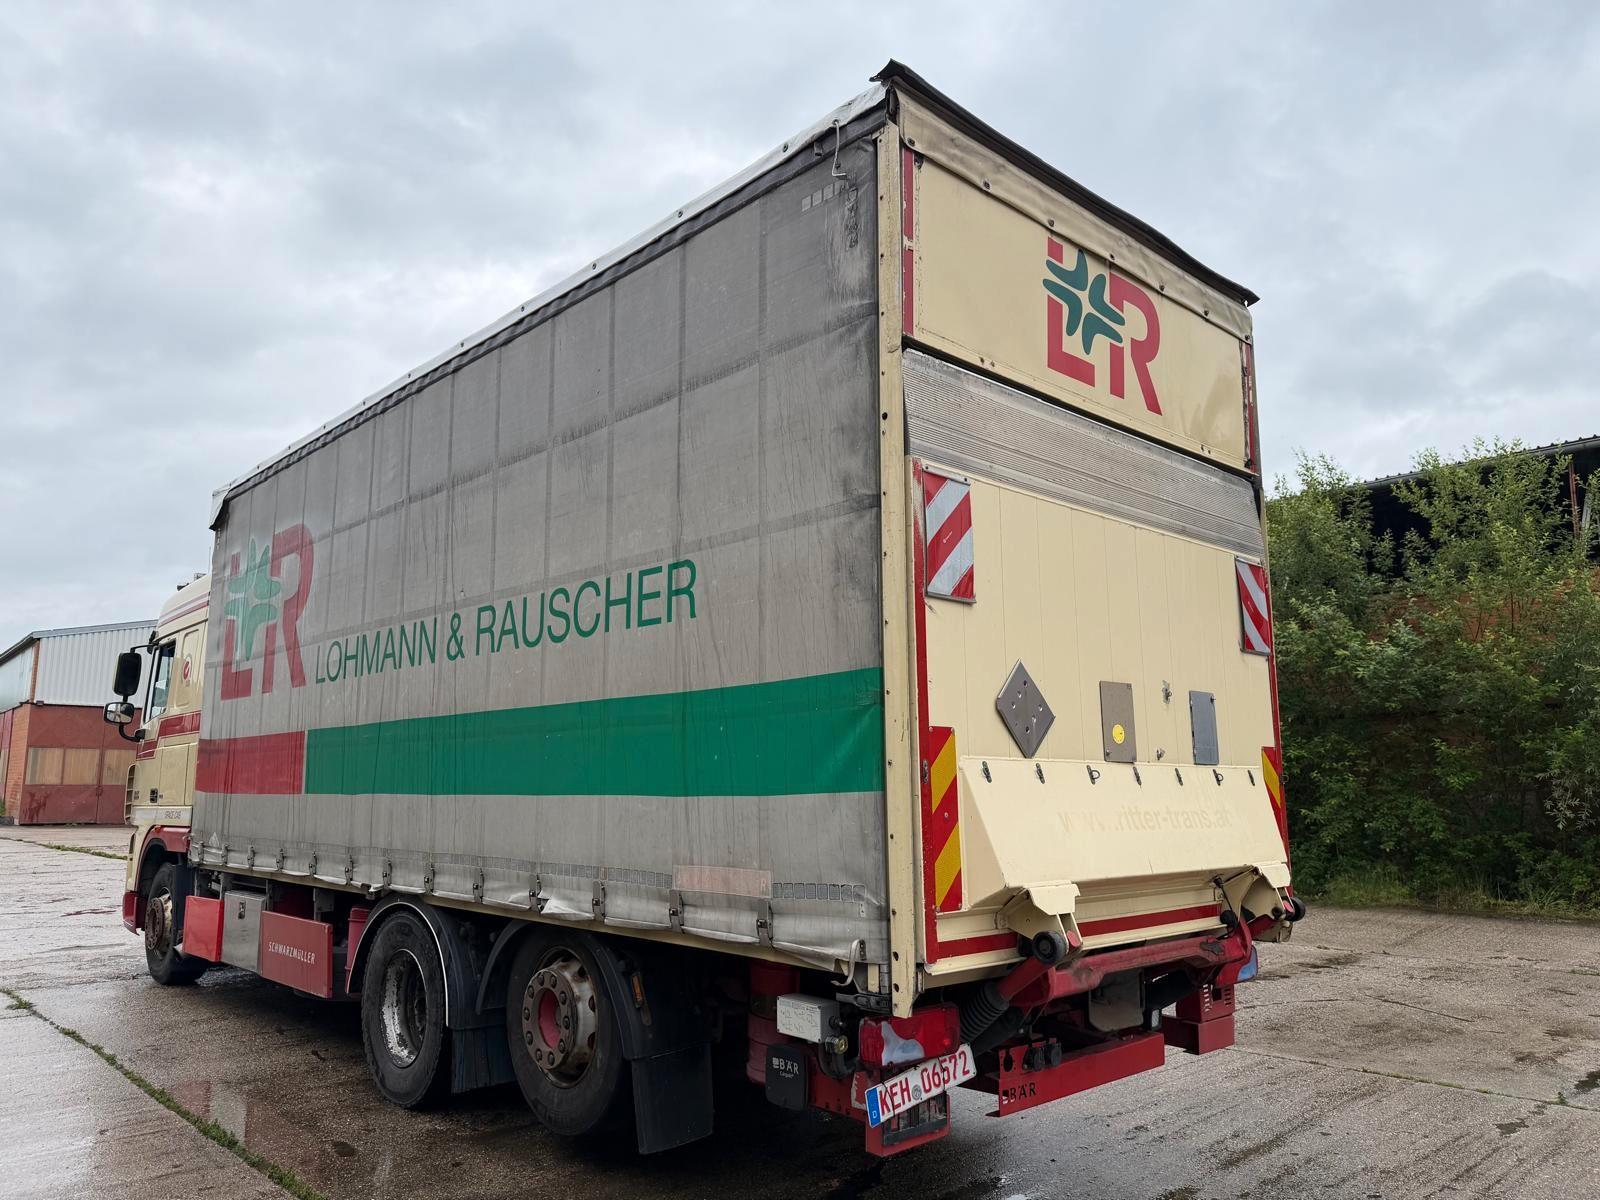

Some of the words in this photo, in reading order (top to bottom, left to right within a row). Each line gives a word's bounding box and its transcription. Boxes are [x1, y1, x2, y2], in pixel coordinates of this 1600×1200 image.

[315, 616, 437, 684] LOHMANN
[446, 612, 465, 661] &
[475, 558, 697, 657] RAUSCHER
[779, 1058, 799, 1075] BÄR
[879, 1077, 912, 1116] KEH
[921, 1050, 970, 1094] 06572
[1010, 1082, 1036, 1103] BÄR
